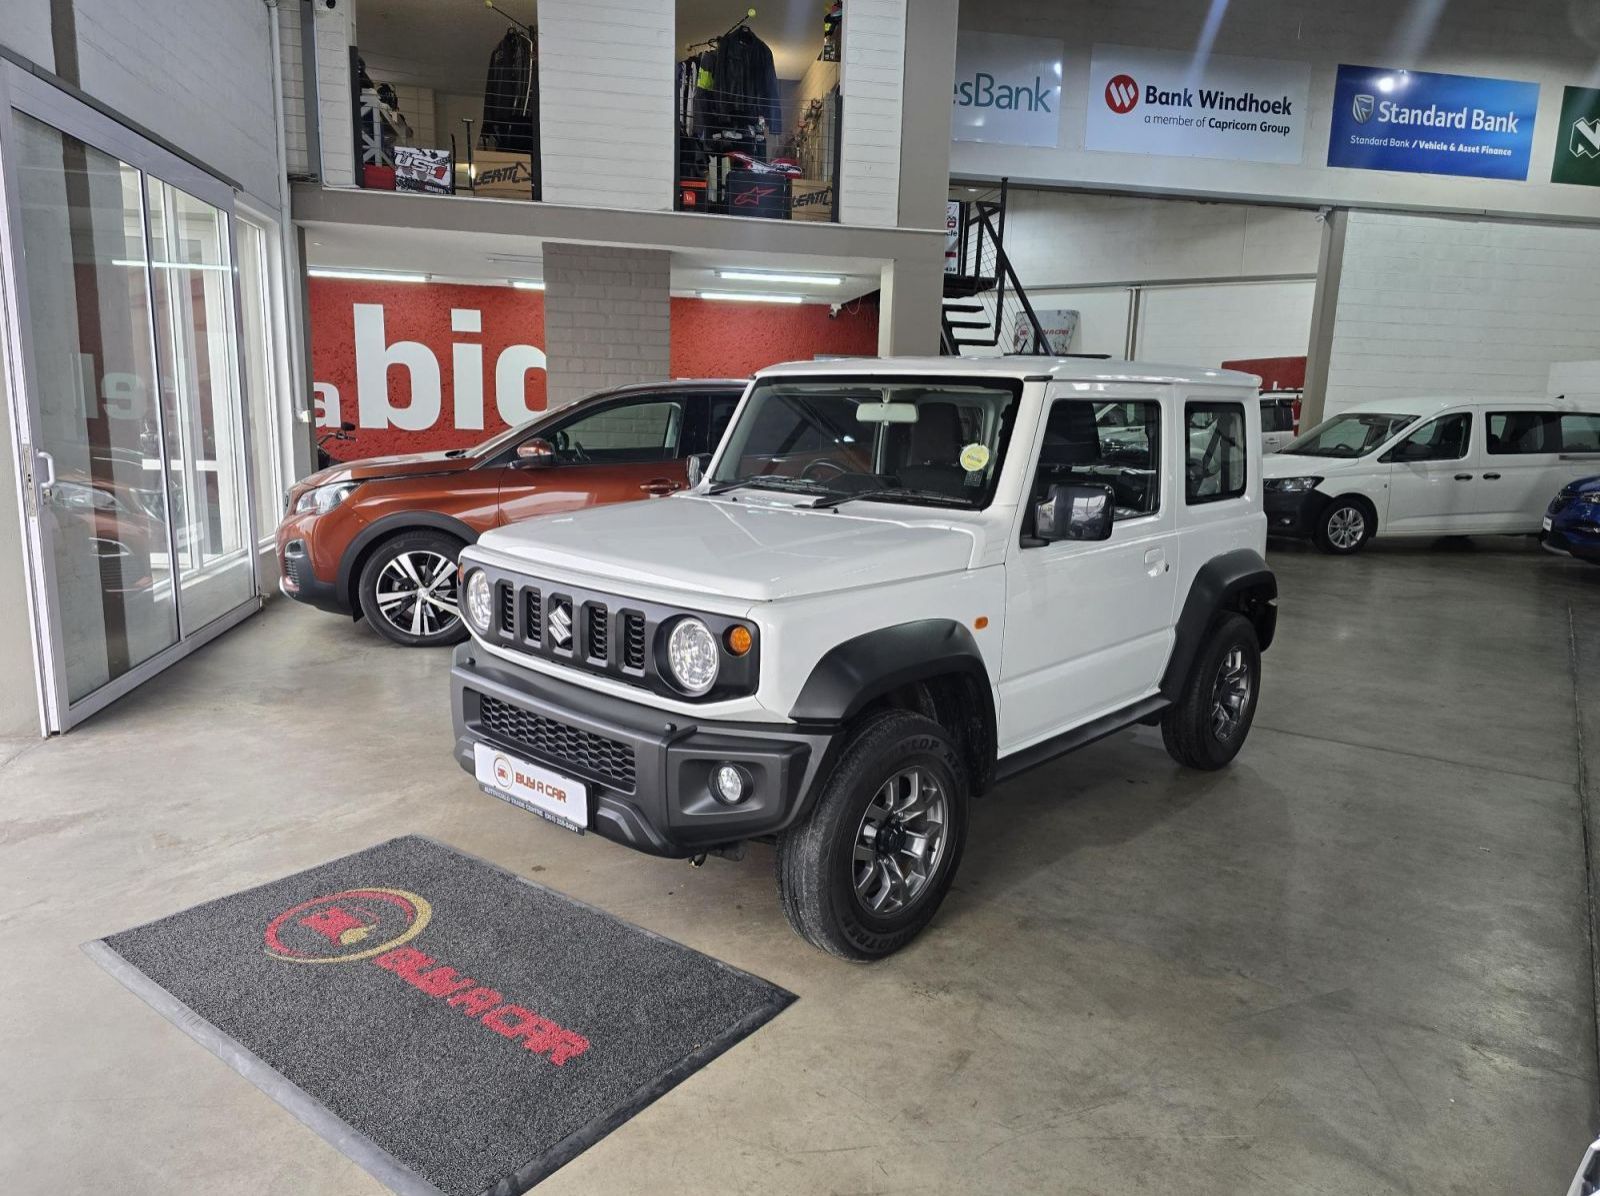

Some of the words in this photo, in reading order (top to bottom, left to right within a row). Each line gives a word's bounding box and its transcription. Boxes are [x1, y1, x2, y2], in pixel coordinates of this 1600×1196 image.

[1145, 85, 1193, 109] Bank
[1198, 89, 1293, 116] Windhoek
[1144, 116, 1151, 124] a
[1153, 114, 1194, 128] member
[1196, 115, 1208, 129] of
[1208, 117, 1257, 133] Capricorn
[1259, 122, 1291, 137] Group
[1378, 101, 1467, 130] Standard
[1471, 109, 1520, 134] Bank
[1350, 135, 1388, 147] Standard
[1389, 137, 1410, 148] Bank
[1419, 140, 1448, 151] Vehicle
[1449, 143, 1456, 151] &
[1457, 143, 1480, 154] Asset
[1481, 145, 1512, 156] Finance
[516, 772, 536, 789] BUY
[536, 783, 544, 794] A
[545, 784, 567, 803] CAR
[372, 946, 477, 998] BUY
[447, 987, 502, 1018] A
[482, 1003, 590, 1067] CAR
